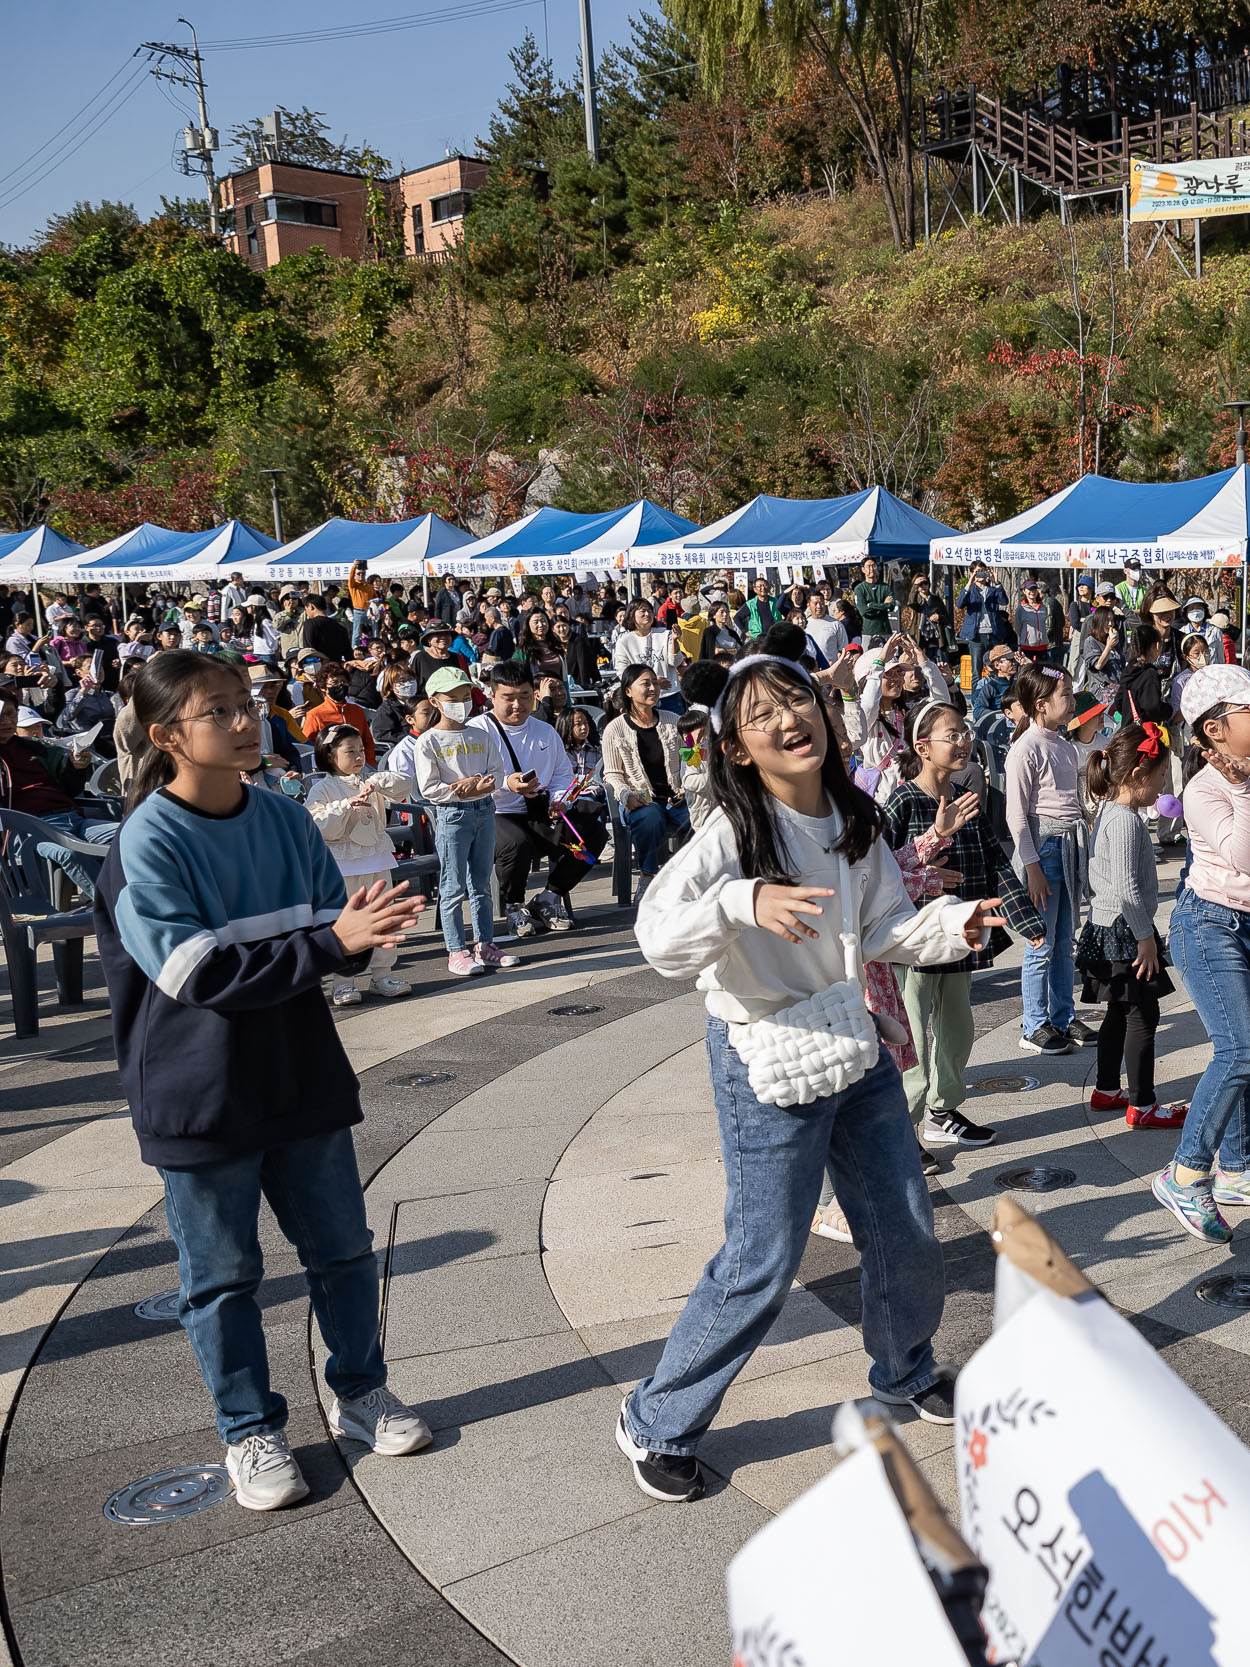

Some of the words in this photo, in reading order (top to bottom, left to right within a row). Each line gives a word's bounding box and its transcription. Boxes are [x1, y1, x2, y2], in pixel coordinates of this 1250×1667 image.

[1184, 174, 1243, 196] 광나루
[660, 553, 681, 566] 광장동
[684, 552, 706, 565] 체육회
[711, 550, 781, 565] 새마을지도자협의회
[945, 547, 1002, 562] 오석한방병원
[1003, 551, 1037, 561] (응급의료지원,
[1038, 551, 1061, 561] 건강상담)
[1096, 548, 1165, 564] 재난구조협회
[1166, 550, 1198, 561] (심폐소생술
[1200, 549, 1216, 560] 체험)
[269, 567, 294, 578] 광장동
[298, 566, 350, 577] 자원봉사캠프
[437, 563, 456, 574] 광장동
[457, 562, 475, 573] 상인회
[532, 559, 553, 572] 광장동
[557, 558, 577, 571] 상인회
[1002, 1487, 1169, 1667] 오석한방
